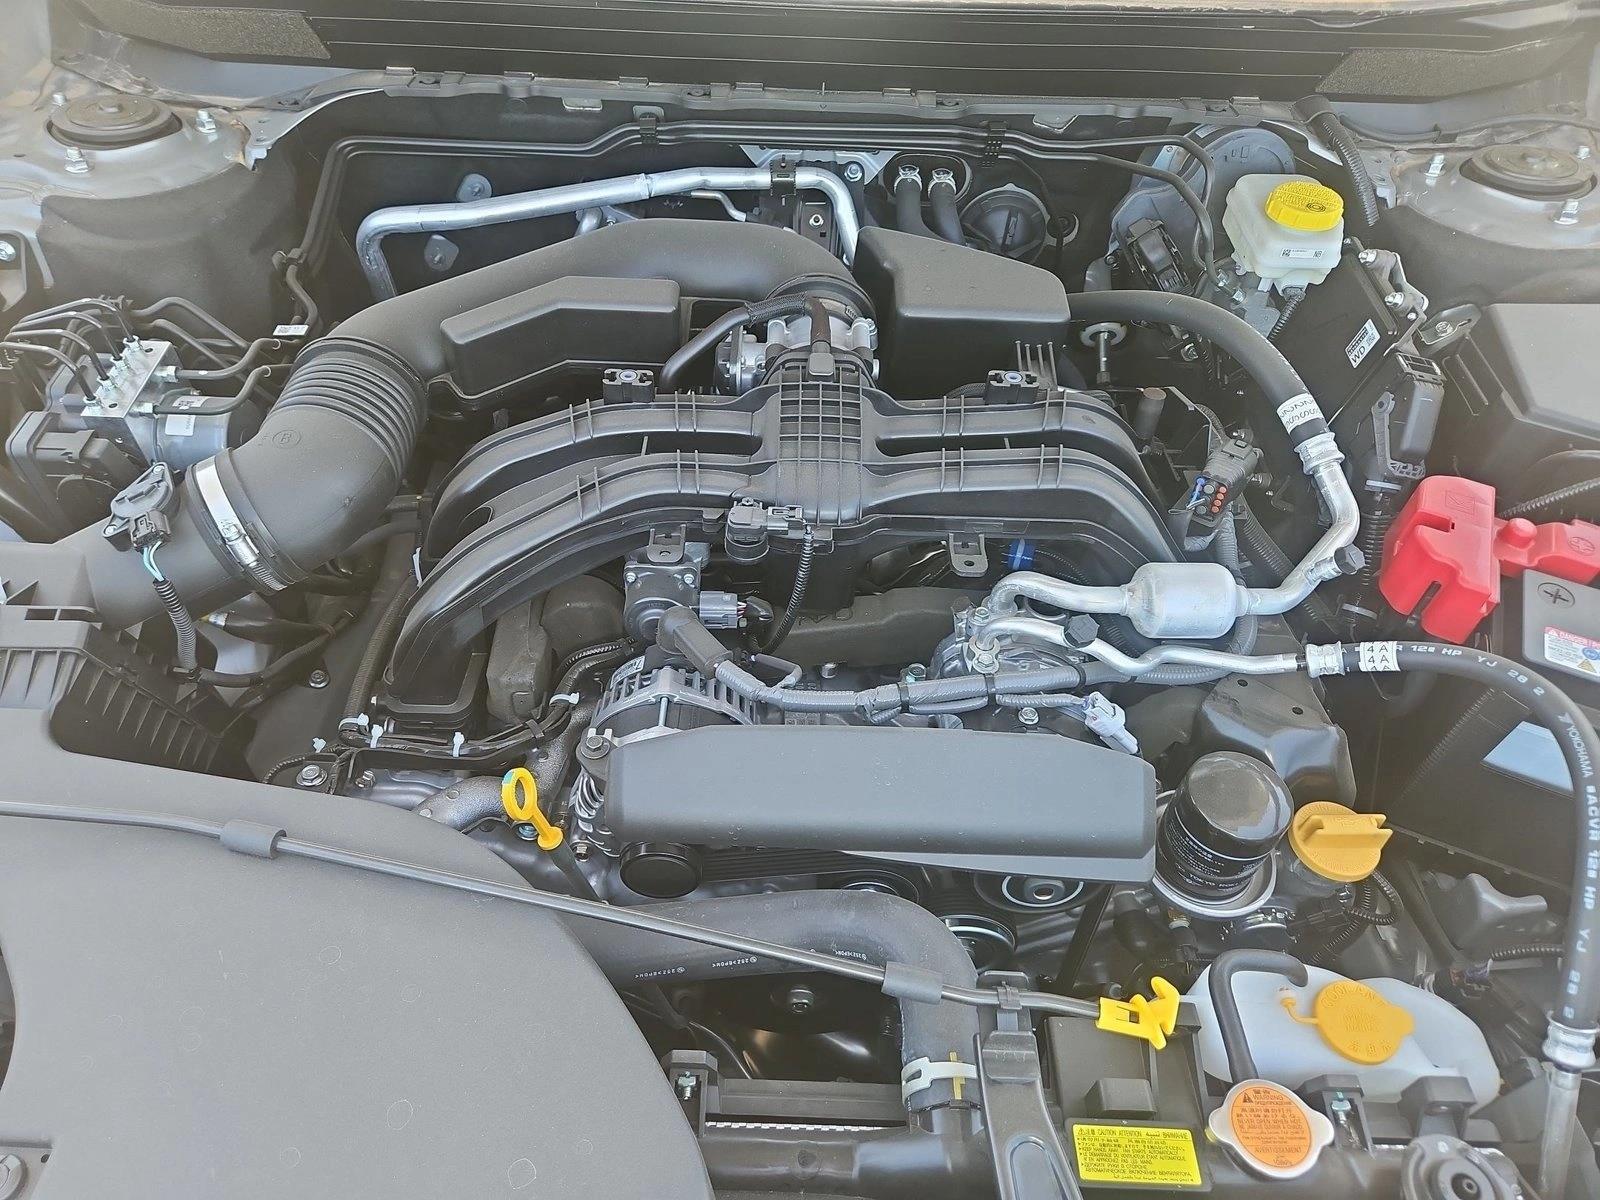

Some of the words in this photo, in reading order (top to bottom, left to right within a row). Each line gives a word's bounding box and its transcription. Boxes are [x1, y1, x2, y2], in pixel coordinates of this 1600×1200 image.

[1441, 648, 1462, 656] HP
[1477, 655, 1497, 667] YJ
[1566, 723, 1594, 778] YOKOHAMA
[1576, 929, 1591, 953] YJ
